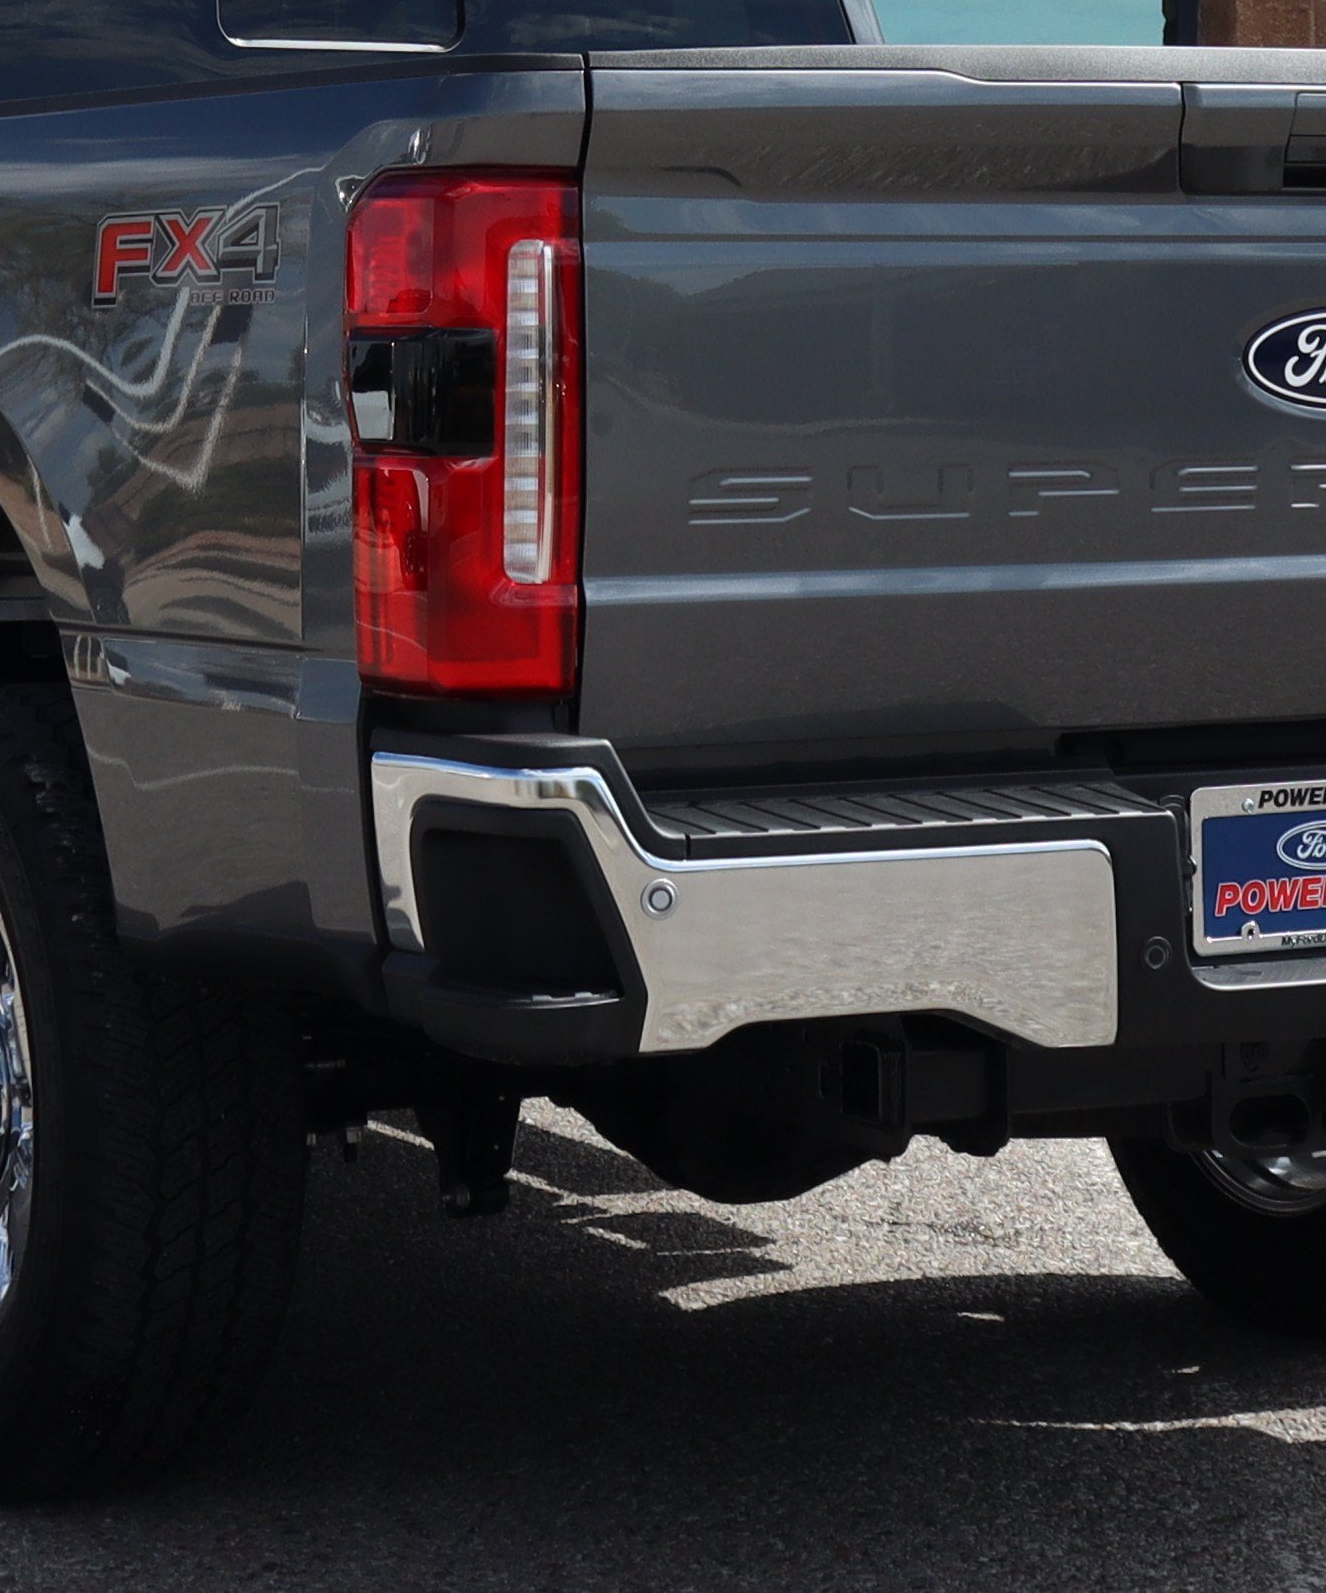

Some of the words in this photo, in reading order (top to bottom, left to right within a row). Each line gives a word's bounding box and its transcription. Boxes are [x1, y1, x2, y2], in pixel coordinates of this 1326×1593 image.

[92, 203, 281, 309] FX4
[189, 289, 223, 306] OFF
[229, 288, 275, 305] ROAD
